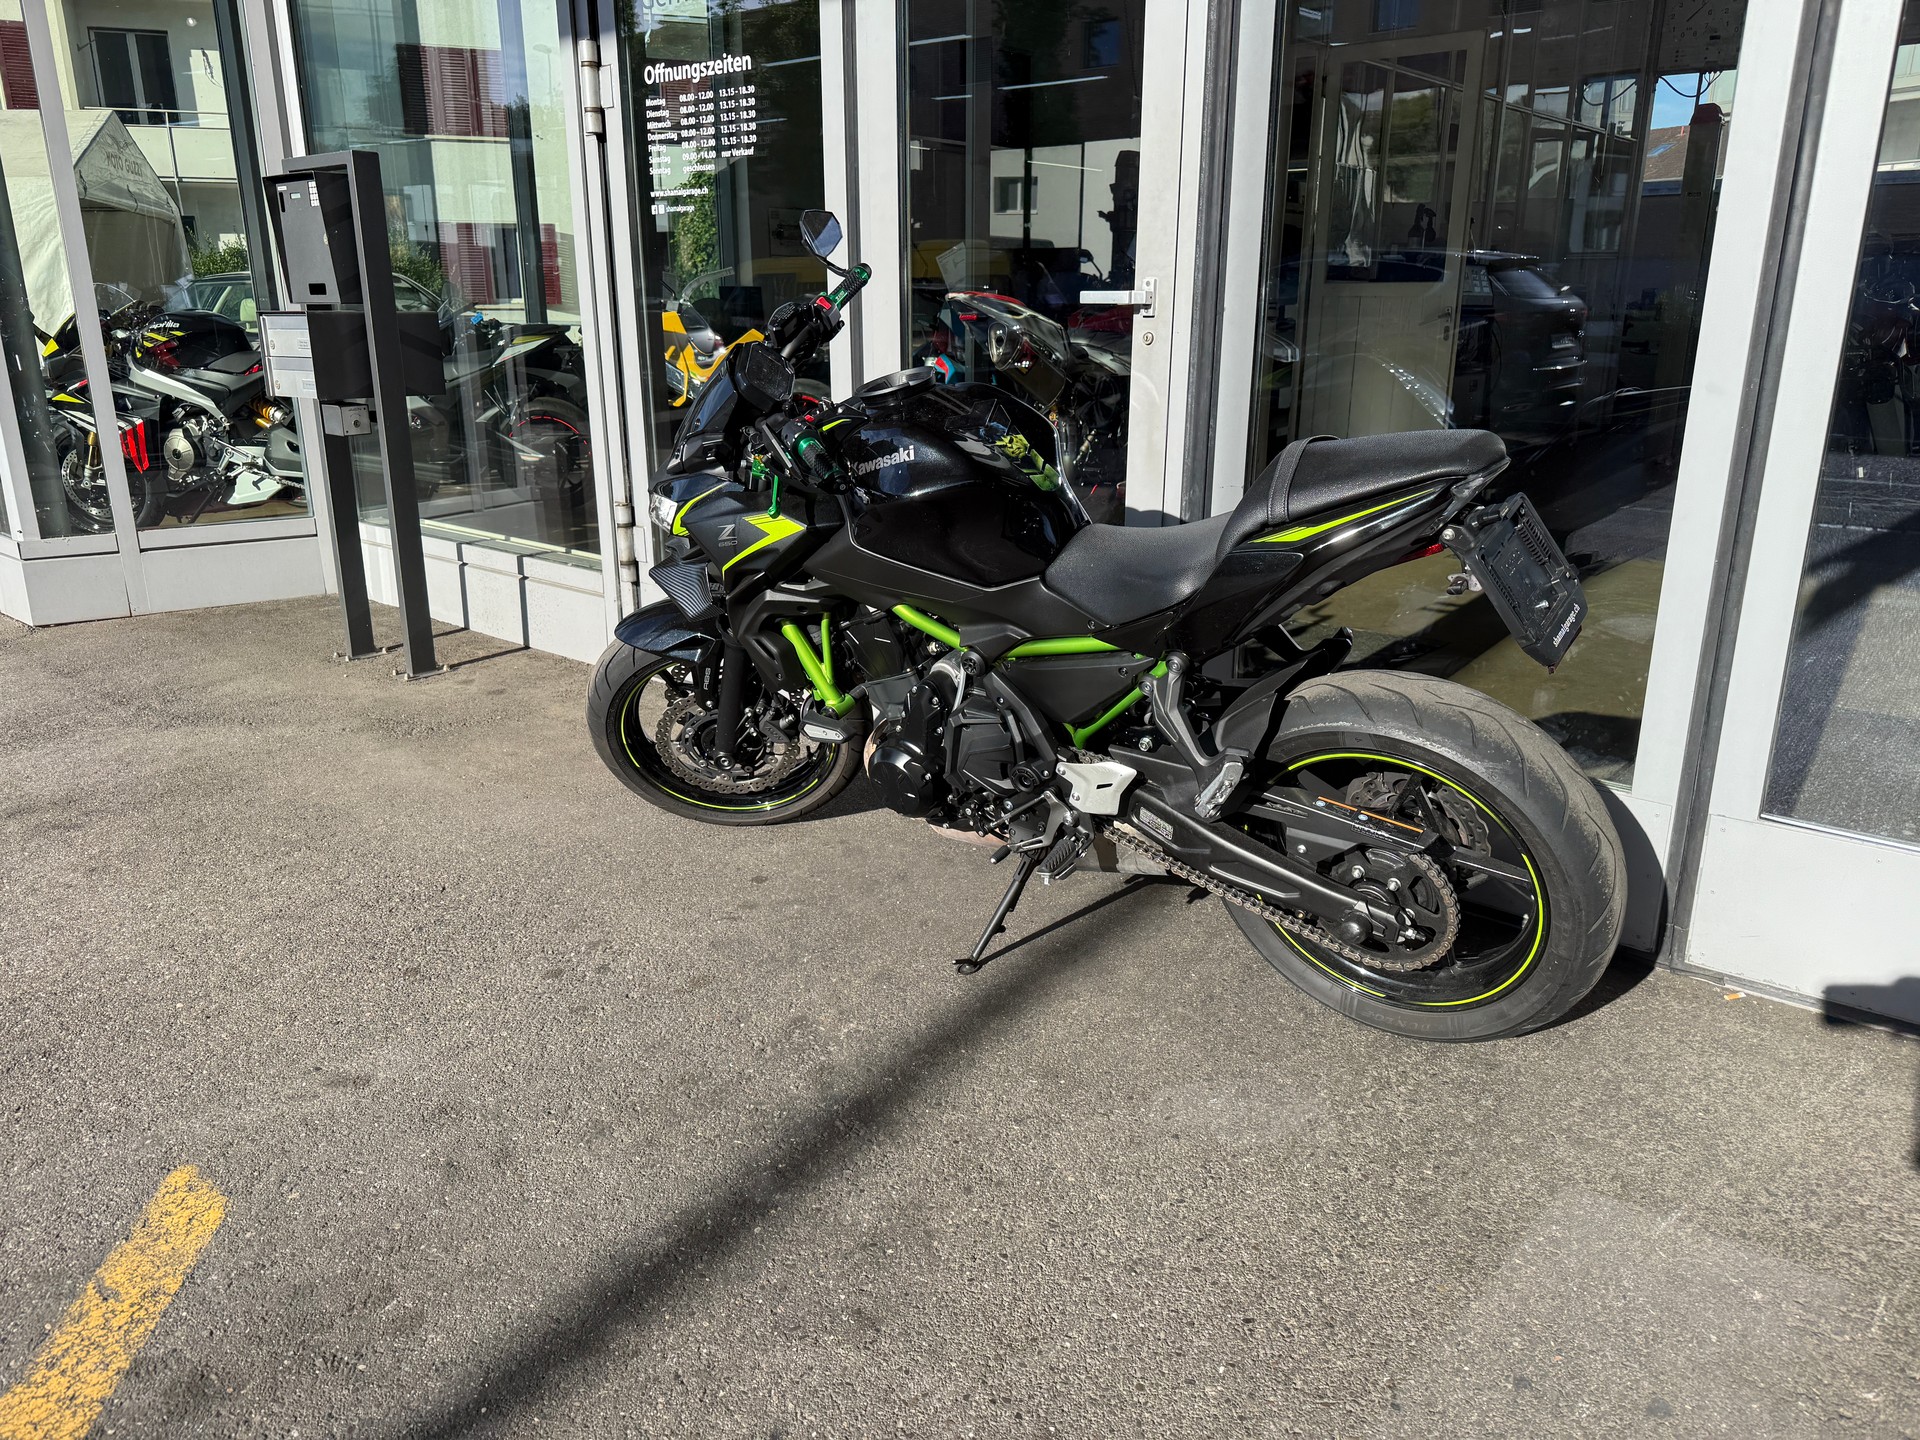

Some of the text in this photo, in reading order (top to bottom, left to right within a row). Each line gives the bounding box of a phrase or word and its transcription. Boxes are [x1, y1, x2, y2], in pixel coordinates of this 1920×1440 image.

[646, 98, 666, 107] Montag
[699, 91, 714, 101] 12.00
[719, 88, 735, 97] 13.15
[646, 110, 669, 118] Dienstag
[699, 103, 714, 113] 12.00
[720, 100, 735, 109] 13.15
[647, 120, 671, 130] Mittwoch
[700, 115, 714, 124] 12.00
[720, 112, 736, 122] 13.15
[700, 126, 715, 136] 12.00
[721, 124, 736, 134] 13.15
[648, 144, 666, 153] Freitag
[700, 139, 716, 148] 12.00
[721, 136, 736, 146] 13.15
[732, 146, 754, 156] Verkauf
[682, 163, 715, 174] geschlossen
[650, 186, 708, 198] www.shamalgarage.ch
[718, 524, 737, 540] Z
[1553, 603, 1580, 647] shamalgarage.ch
[703, 667, 711, 690] ABS
